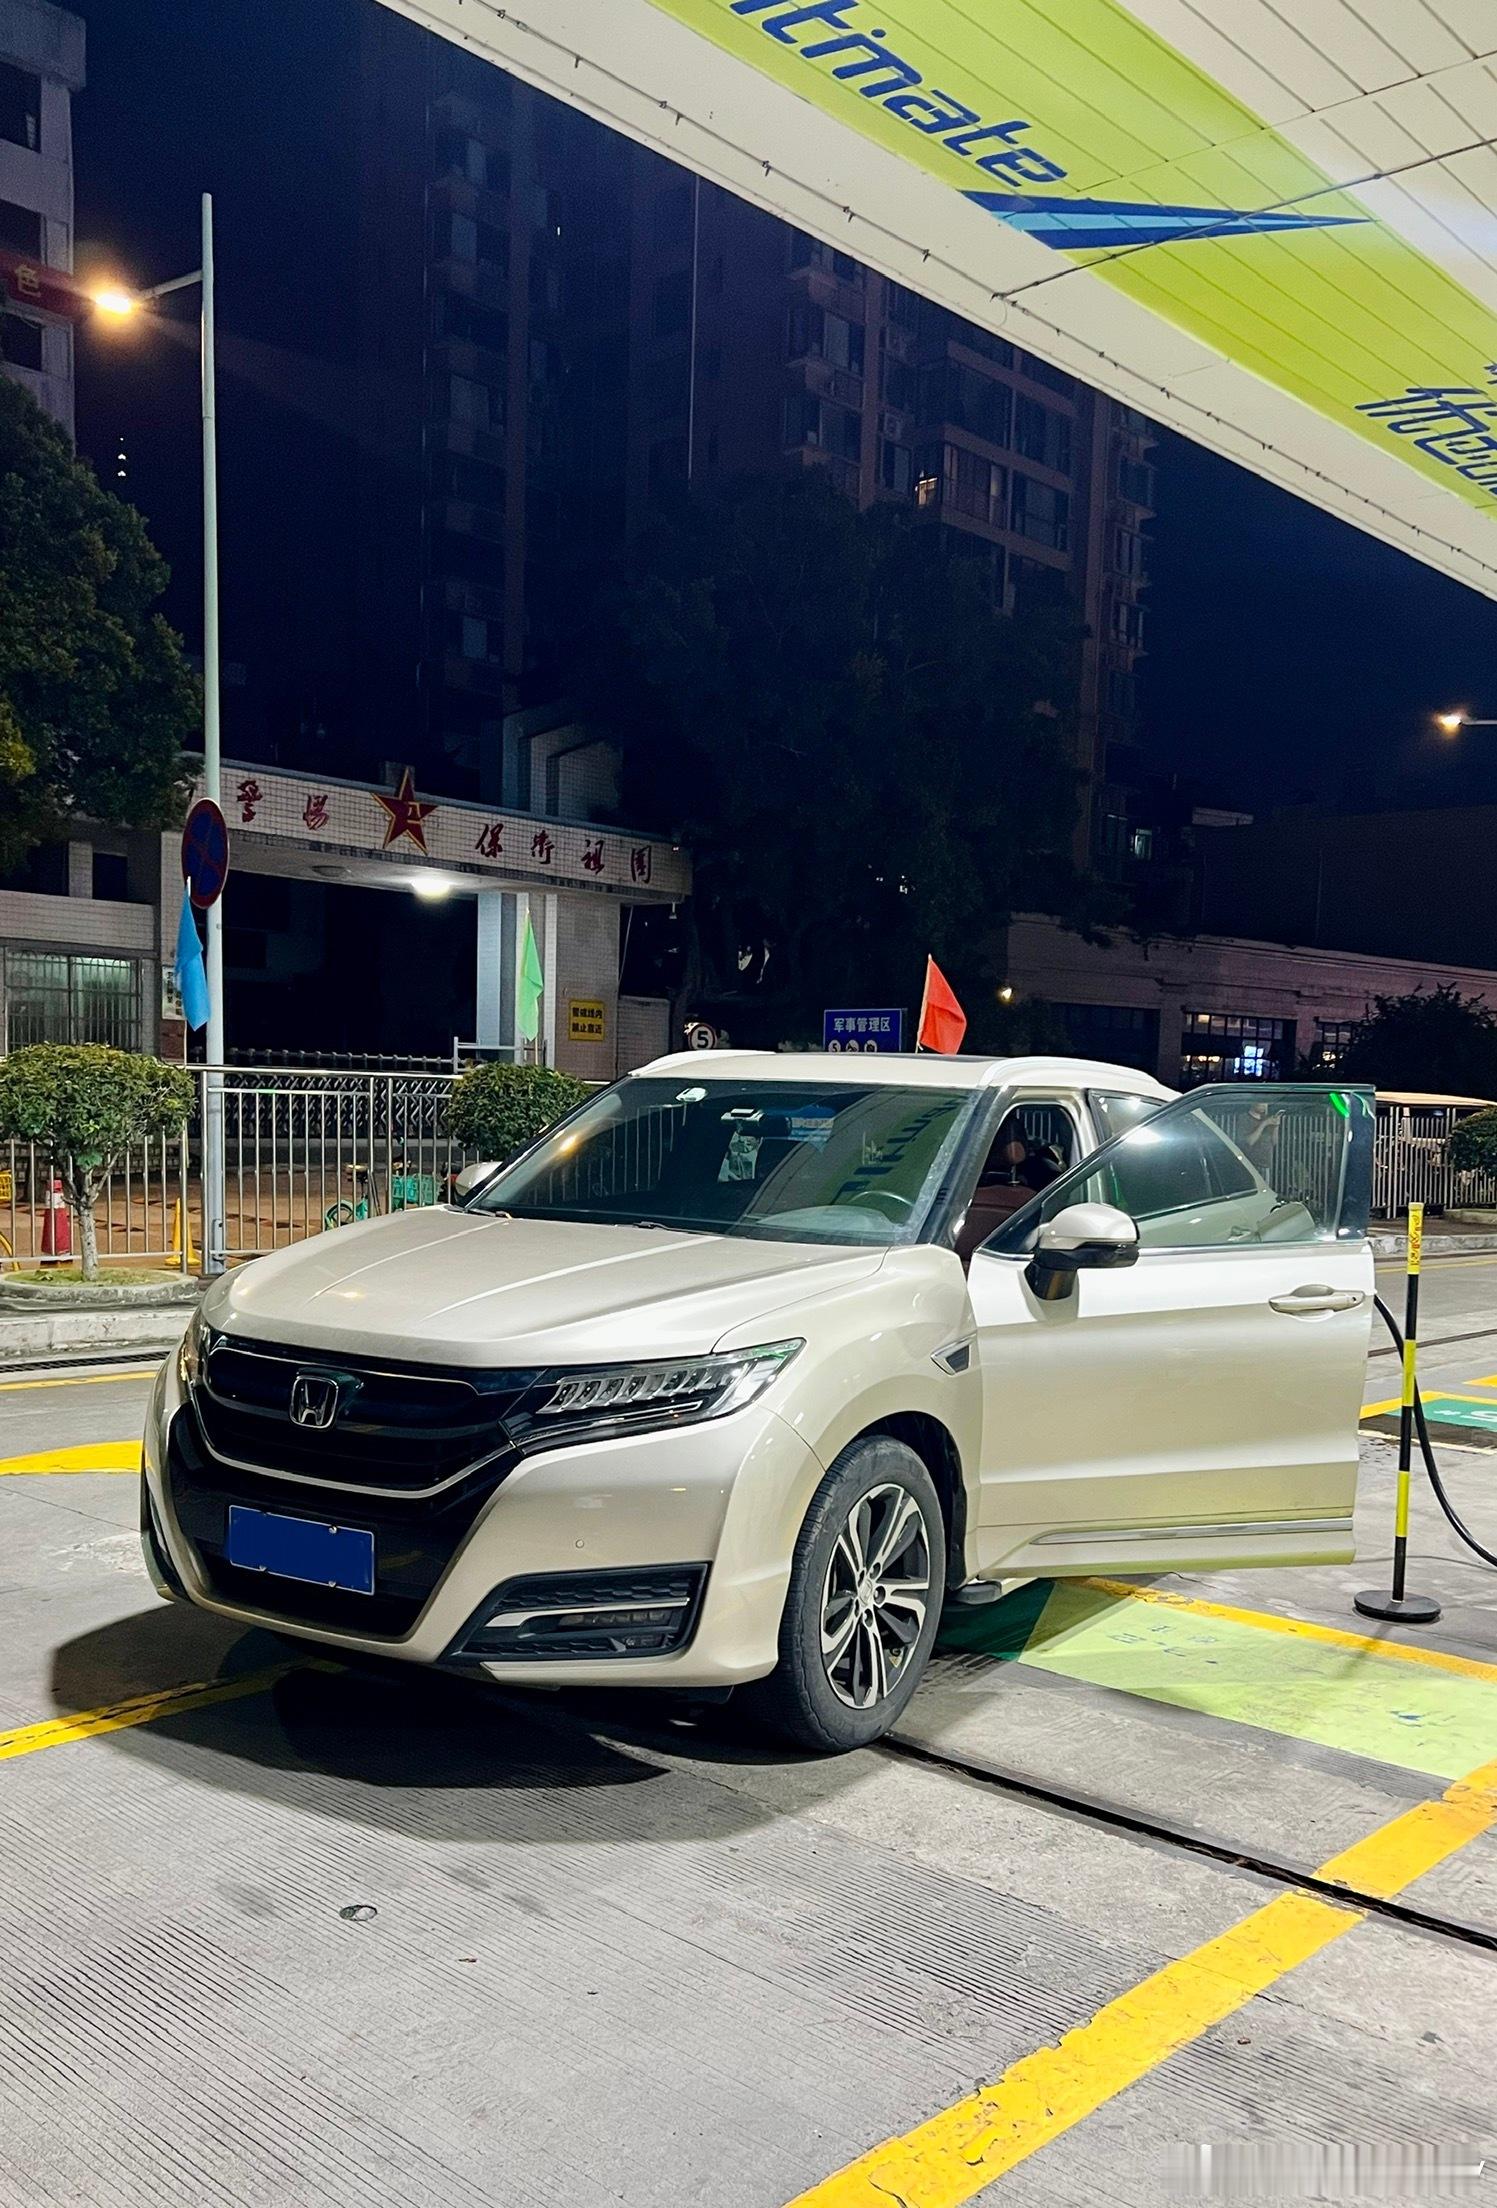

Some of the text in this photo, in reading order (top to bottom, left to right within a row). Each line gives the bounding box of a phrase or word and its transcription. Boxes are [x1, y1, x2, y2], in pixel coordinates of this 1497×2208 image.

[729, 0, 1068, 187] timate
[834, 1017, 891, 1033] 军事管理区
[697, 1030, 709, 1049] 5
